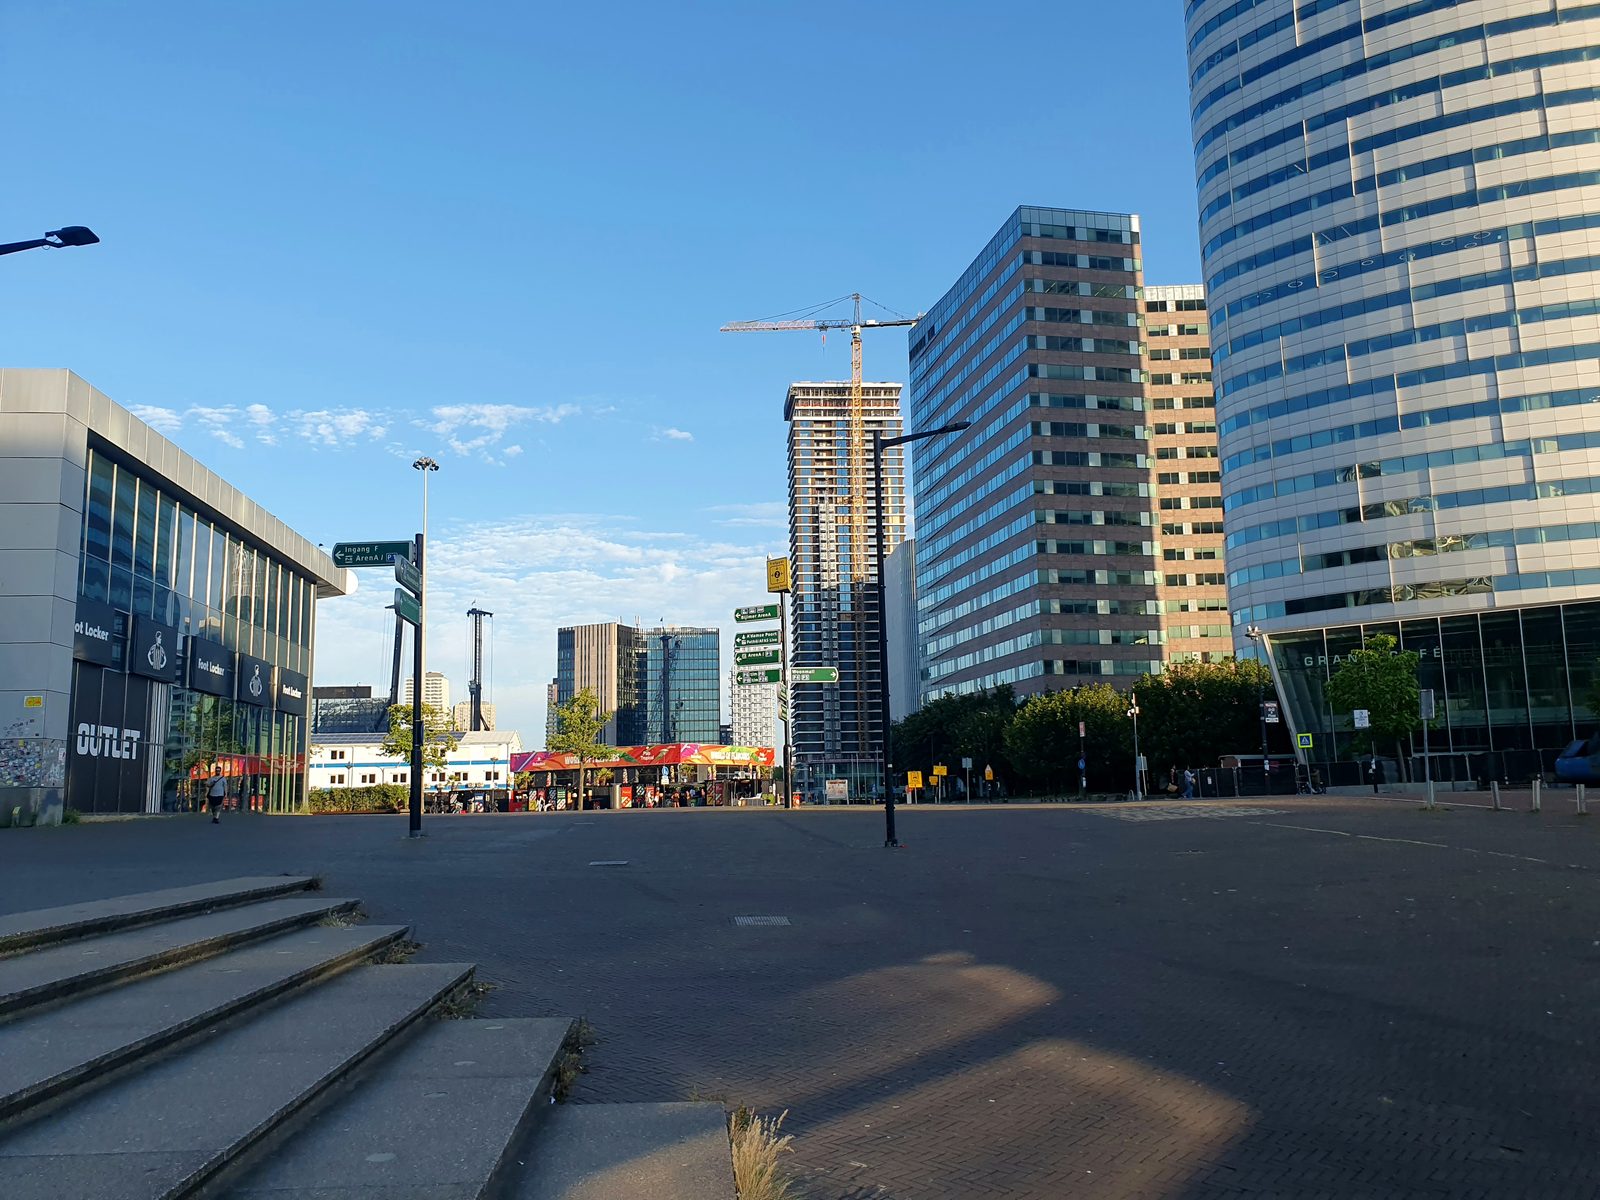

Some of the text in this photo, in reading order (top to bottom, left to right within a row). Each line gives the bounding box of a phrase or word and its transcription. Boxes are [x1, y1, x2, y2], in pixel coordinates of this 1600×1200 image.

[85, 622, 109, 640] Locker
[1304, 646, 1440, 666] GRAN CFÉ
[198, 658, 224, 676] Foot Locker
[282, 684, 290, 695] Foot
[76, 722, 140, 760] OUTLET
